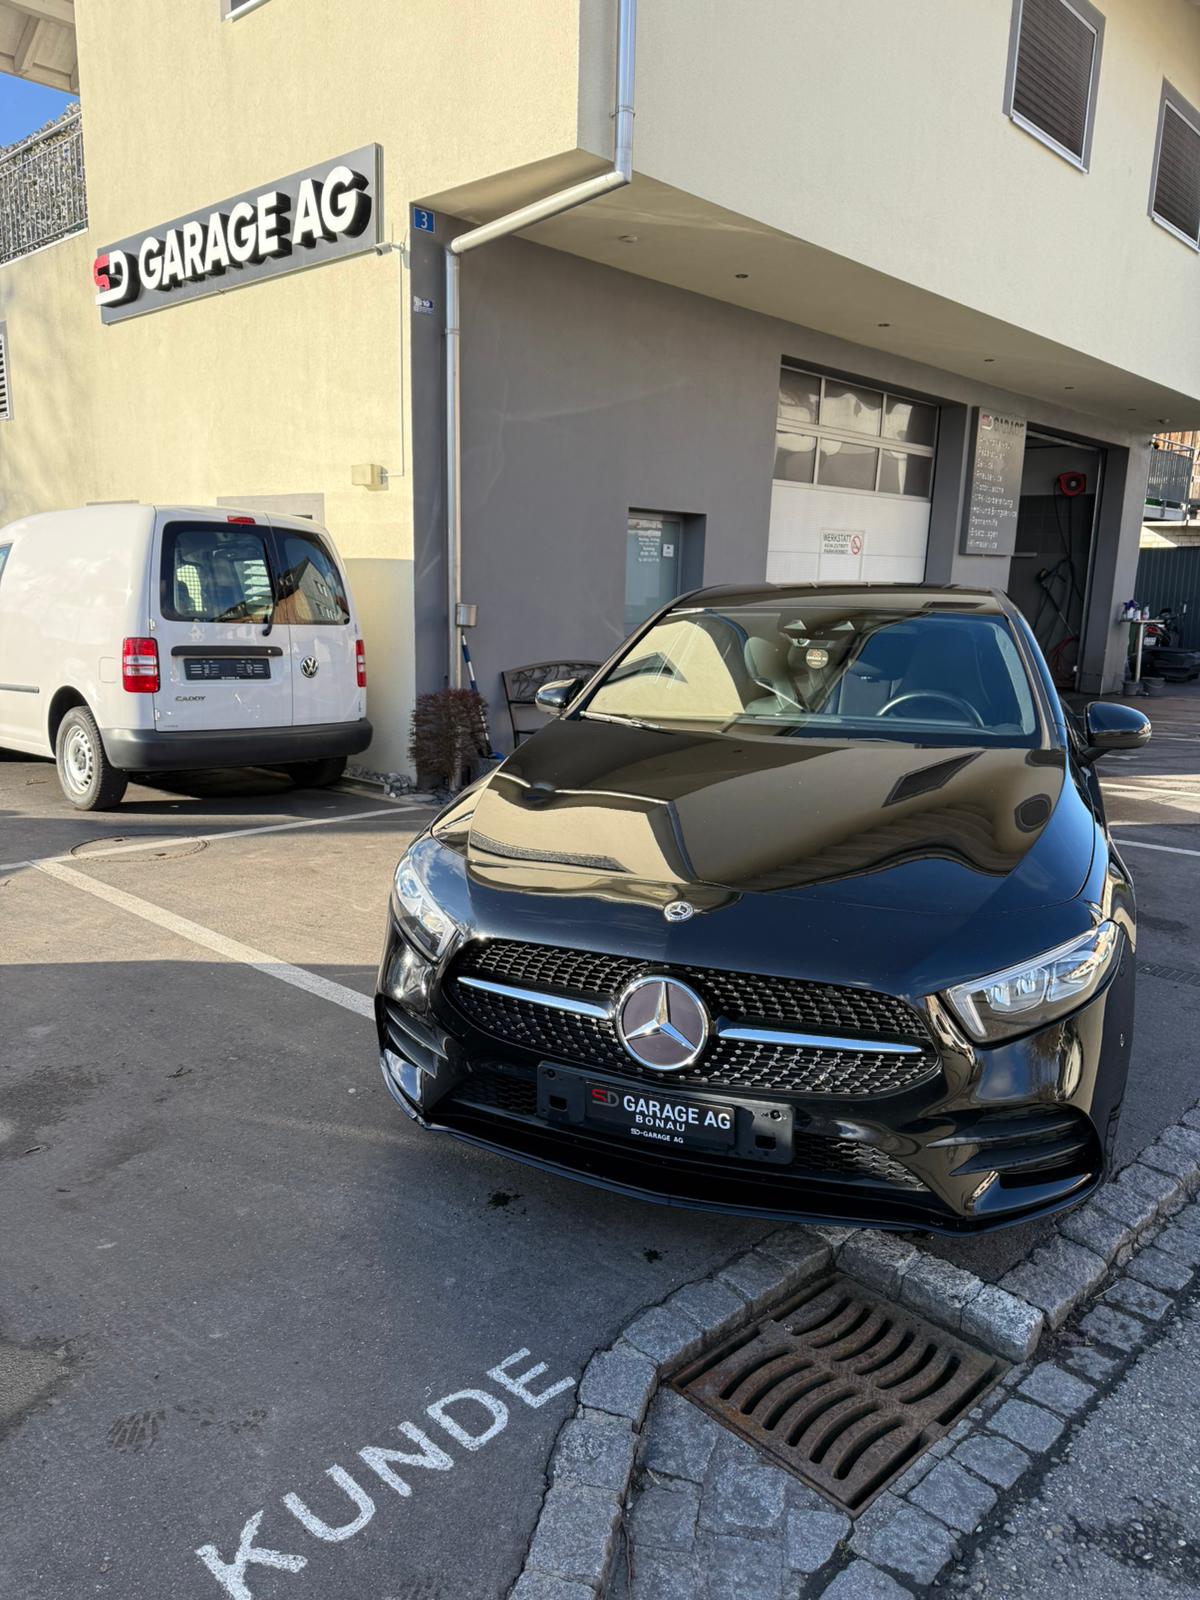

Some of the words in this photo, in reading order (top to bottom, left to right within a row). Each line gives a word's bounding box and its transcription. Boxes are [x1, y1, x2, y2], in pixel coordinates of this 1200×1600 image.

[420, 211, 428, 229] 3
[93, 249, 131, 306] SD
[138, 191, 282, 290] GARAGE
[292, 165, 366, 246] AG
[623, 1095, 699, 1125] GARAGE
[704, 1110, 731, 1130] AG
[635, 1114, 686, 1132] BONAU
[630, 1128, 671, 1142] SD-GARAGE
[673, 1136, 684, 1144] AG
[194, 1347, 577, 1600] KUNDE
